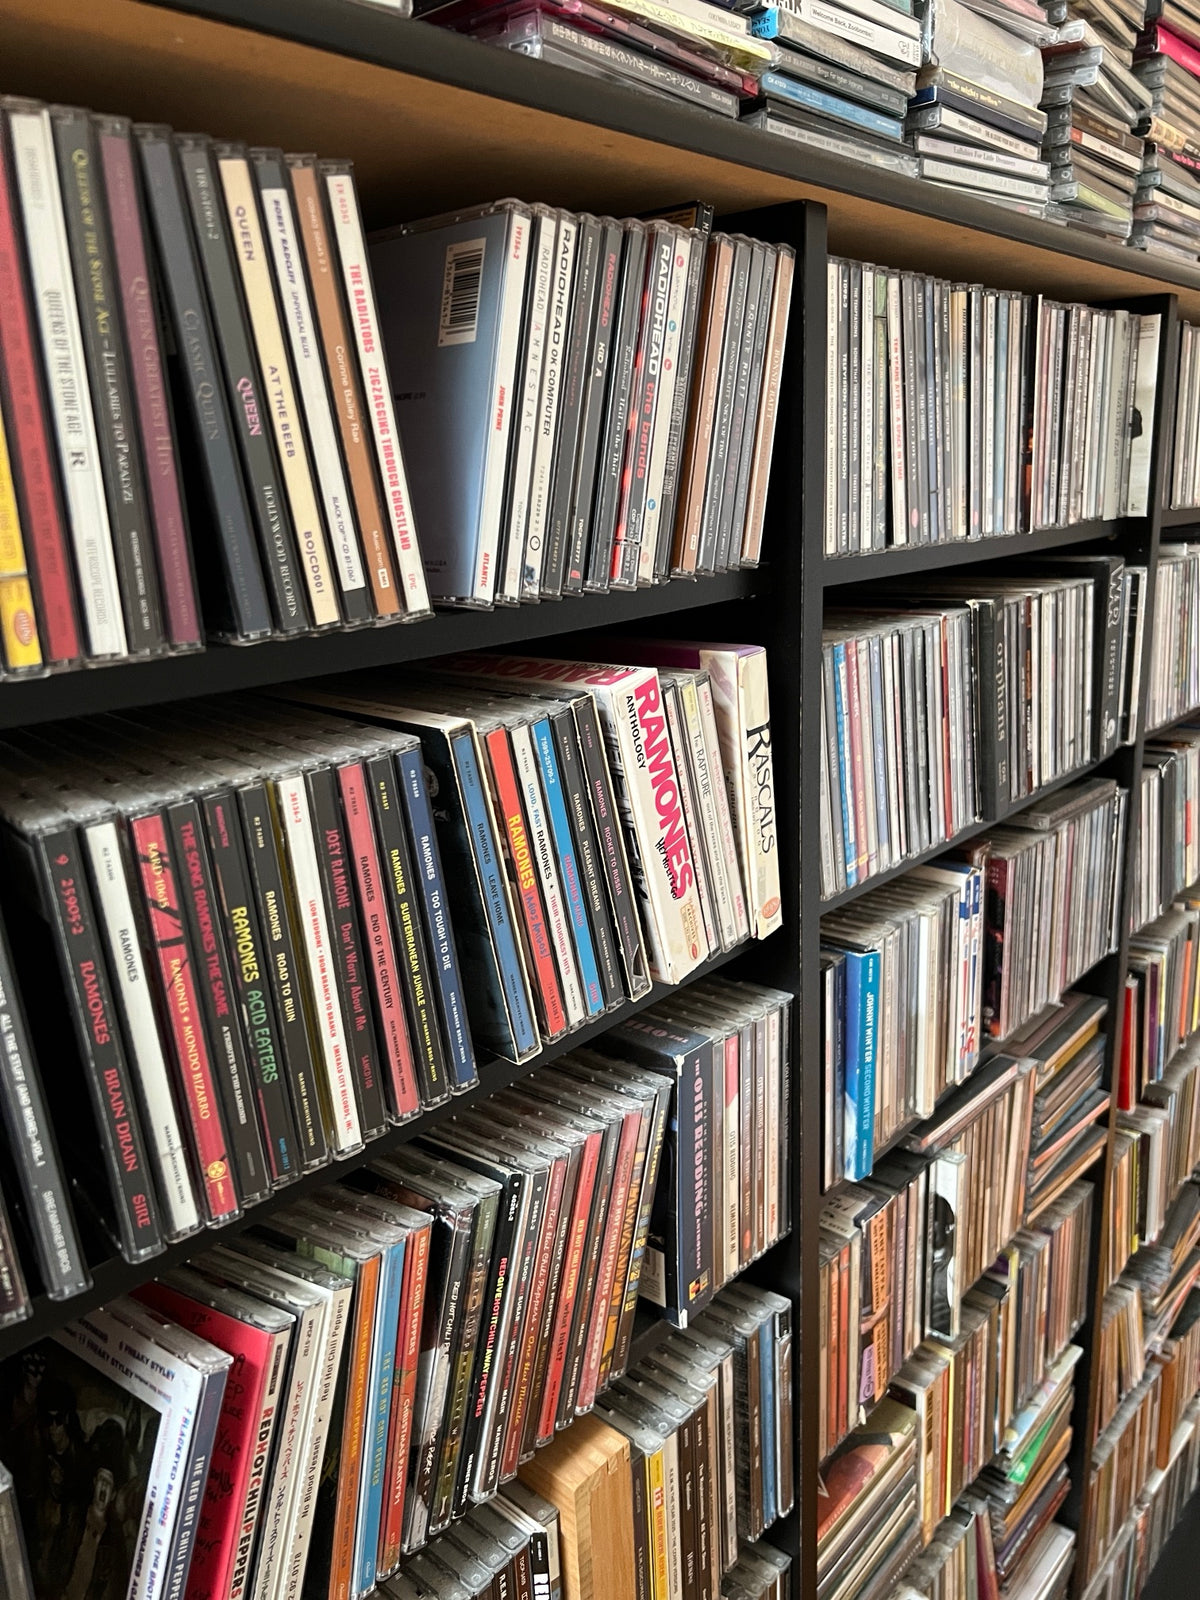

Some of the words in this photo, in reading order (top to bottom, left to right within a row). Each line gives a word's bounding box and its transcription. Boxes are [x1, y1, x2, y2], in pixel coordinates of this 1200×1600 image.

[235, 205, 255, 261] QUEEN
[273, 199, 286, 236] BOBBY
[349, 264, 364, 286] THE
[552, 228, 572, 346] RADIOHEAD
[601, 252, 617, 328] RADIOHEAD
[353, 289, 375, 354] RADIATORS
[648, 244, 671, 376] RADIOHEAD
[56, 354, 73, 375] THE
[550, 348, 559, 364] OK
[597, 341, 606, 364] KID
[269, 365, 281, 385] AT
[59, 374, 79, 414] STONE
[274, 390, 288, 418] THE
[335, 345, 349, 387] Corinne
[342, 388, 356, 421] Bailey
[350, 423, 361, 444] Rae
[368, 367, 390, 435] ZIGZAGGING
[498, 385, 506, 408] JOHN
[543, 367, 557, 437] COMPUTER
[616, 397, 625, 419] Hail
[645, 382, 655, 415] the
[66, 416, 81, 434] AGE
[281, 423, 296, 459] BEEB
[613, 433, 621, 448] the
[615, 420, 623, 431] to
[718, 424, 726, 437] OF
[155, 434, 172, 476] HITS
[381, 437, 400, 489] THROUGH
[610, 451, 619, 477] Thief
[637, 420, 651, 480] bends
[236, 377, 262, 436] QUEEN
[262, 485, 286, 562] HOLLYWOOD
[279, 565, 297, 617] RECORDS
[392, 490, 412, 551] GHOSTLAND
[303, 531, 325, 594] BOJCD001
[480, 551, 490, 588] ATLANTIC
[408, 573, 418, 590] EPIC
[995, 642, 1006, 741] orphans
[625, 695, 647, 770] ANTHOLOGY
[634, 676, 693, 898] RAMONES
[696, 750, 712, 799] RAPTURE
[746, 720, 776, 854] RASCALS
[527, 782, 538, 808] LOUD,
[595, 779, 608, 819] RAMONES
[180, 820, 197, 850] THE
[533, 808, 543, 829] FAST
[325, 828, 342, 858] JOEY
[420, 835, 436, 880] RAMONES
[476, 822, 492, 865] RAMONES
[508, 814, 536, 890] RAMONES
[536, 829, 553, 881] RAMONES
[573, 793, 586, 832] RAMONES
[582, 840, 595, 881] PLEASANT
[589, 881, 600, 912] DREAMS
[604, 826, 615, 855] ROCKET
[185, 850, 204, 889] SONG
[360, 855, 375, 903] RAMONES
[608, 856, 616, 868] TO
[331, 858, 350, 911] RAMONE
[430, 889, 441, 909] TOO
[488, 874, 499, 900] LEAVE
[612, 868, 622, 897] RUSSIA
[193, 890, 216, 953] RAMONES
[265, 890, 283, 942] RAMONES
[493, 901, 505, 926] HOME
[549, 894, 559, 914] THEIR
[370, 913, 381, 933] END
[390, 849, 406, 895] RAMONES
[400, 902, 420, 973] SUBTERRANEAN
[412, 973, 427, 1007] JUNGLE
[432, 909, 448, 941] TOUGH
[554, 914, 567, 954] TOUGHEST
[118, 929, 139, 983] RAMONES
[231, 906, 260, 983] RAMONES
[374, 934, 385, 949] OF
[439, 942, 449, 955] TO
[206, 953, 222, 980] THE
[276, 952, 290, 982] ROAD
[376, 952, 387, 971] THE
[443, 954, 452, 971] DIE
[560, 954, 571, 976] HITS
[170, 958, 191, 1014] RAMONES
[211, 979, 229, 1018] SAME
[280, 984, 292, 996] TO
[379, 970, 394, 1010] CENTURY
[247, 989, 268, 1026] ACID
[284, 997, 297, 1023] RUIN
[355, 1015, 368, 1031] Me
[866, 991, 874, 1027] JOHNNY
[183, 1025, 200, 1071] MONDO
[254, 1028, 279, 1084] EATERS
[865, 1028, 873, 1063] WINTER
[80, 959, 110, 1045] RAMONES
[104, 1068, 127, 1119] BRAIN
[116, 1120, 138, 1172] DRAIN
[132, 1193, 151, 1229] SIRE
[191, 1072, 210, 1120] BIZARRO
[693, 1077, 703, 1123] OTIS
[694, 1124, 704, 1217] REDDING
[418, 1235, 427, 1258] RED
[416, 1258, 424, 1281] HOT
[412, 1281, 422, 1310] CHILI
[331, 1299, 345, 1337] Peppers
[408, 1310, 420, 1356] PEPPERS
[327, 1338, 338, 1362] Chili
[525, 1336, 535, 1359] One
[324, 1362, 334, 1382] Hot
[321, 1381, 331, 1402] Red
[514, 1385, 527, 1426] Minute
[193, 1455, 205, 1478] THE
[187, 1479, 202, 1503] RED
[304, 1474, 316, 1504] Blood
[183, 1504, 196, 1529] HOT
[301, 1504, 310, 1518] No
[176, 1530, 192, 1561] CHILI
